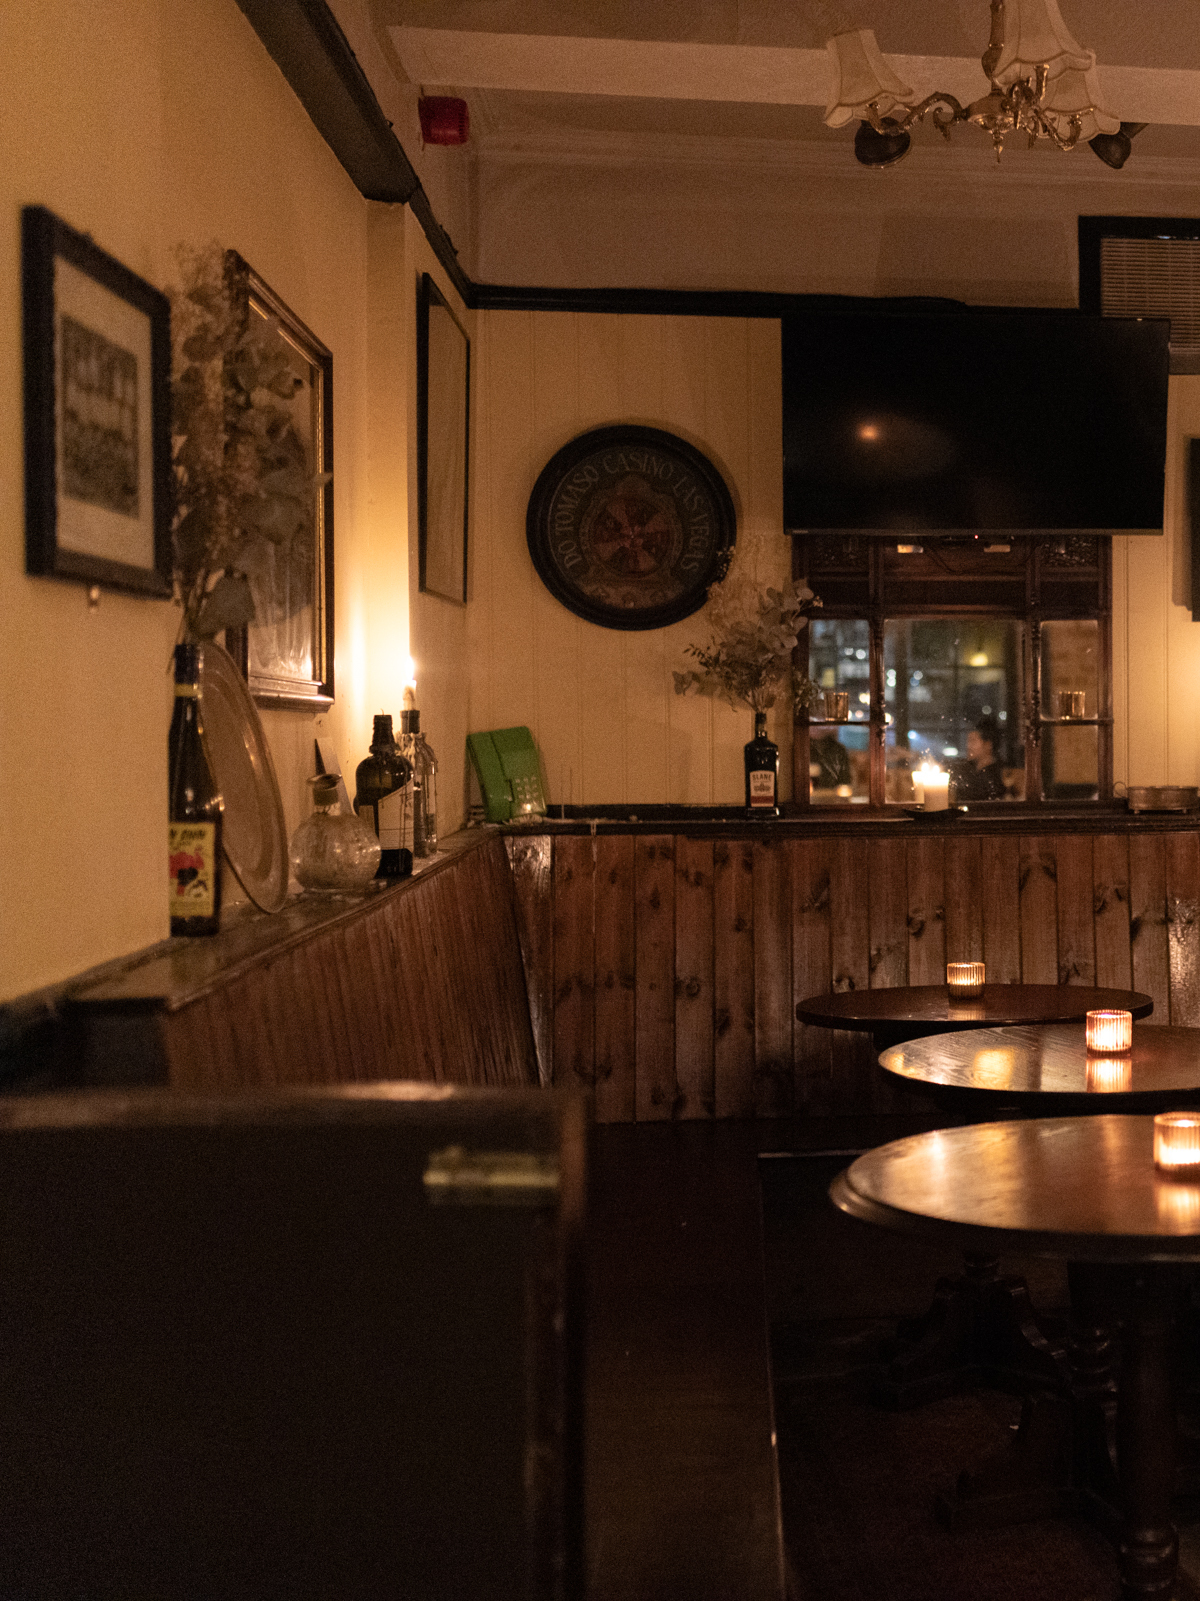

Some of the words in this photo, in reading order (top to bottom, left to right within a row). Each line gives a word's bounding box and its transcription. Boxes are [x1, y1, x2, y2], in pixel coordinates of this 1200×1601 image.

[602, 452, 674, 480] CASINO
[555, 464, 599, 536] TOMASO
[672, 475, 704, 512] LAS
[680, 513, 710, 573] VEGAS
